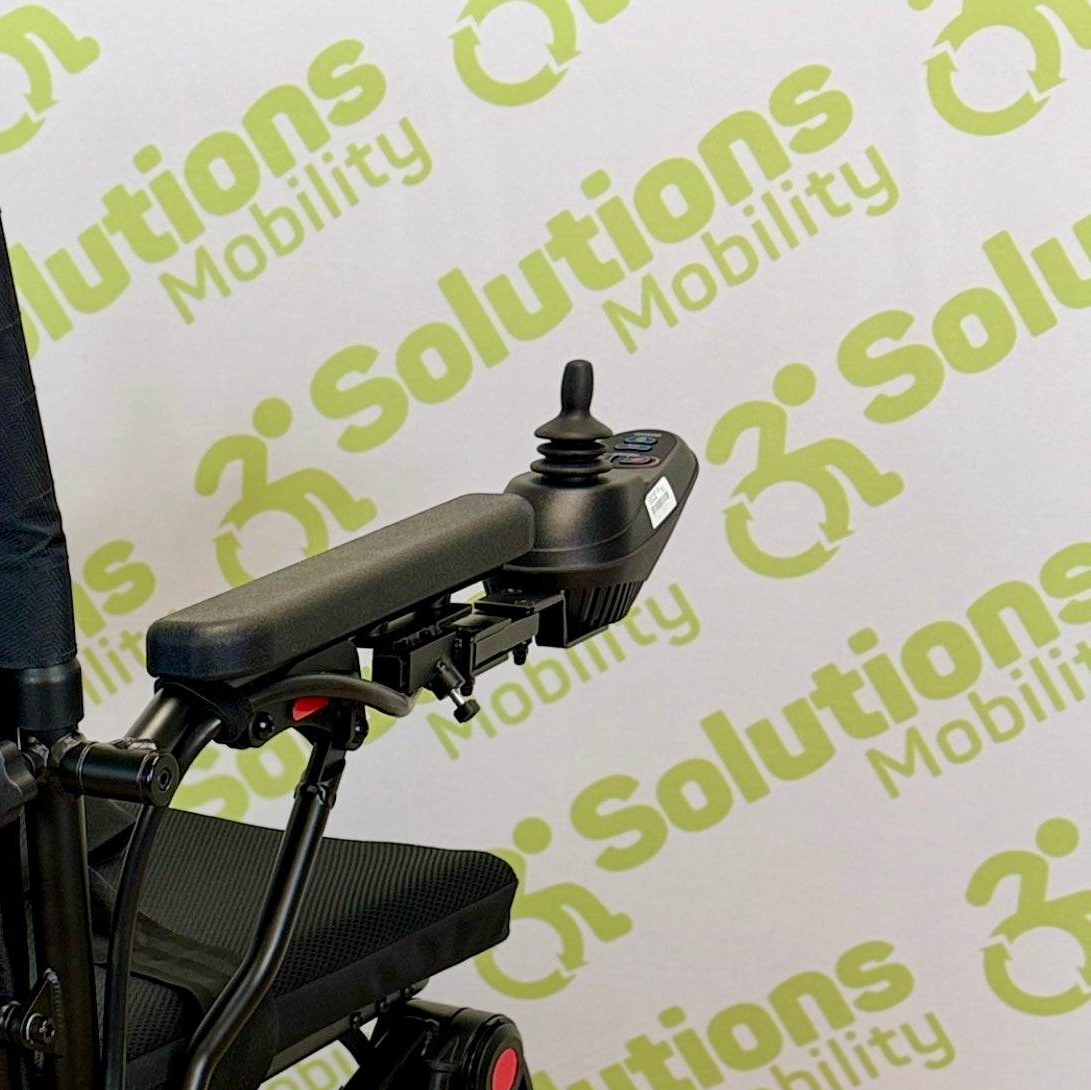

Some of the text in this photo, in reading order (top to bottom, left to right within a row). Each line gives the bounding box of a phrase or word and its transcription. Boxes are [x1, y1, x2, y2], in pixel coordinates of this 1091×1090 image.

[8, 39, 387, 360] lutions
[158, 118, 432, 325] Mobility
[309, 64, 853, 455] Solutions
[602, 146, 899, 354] Mobility
